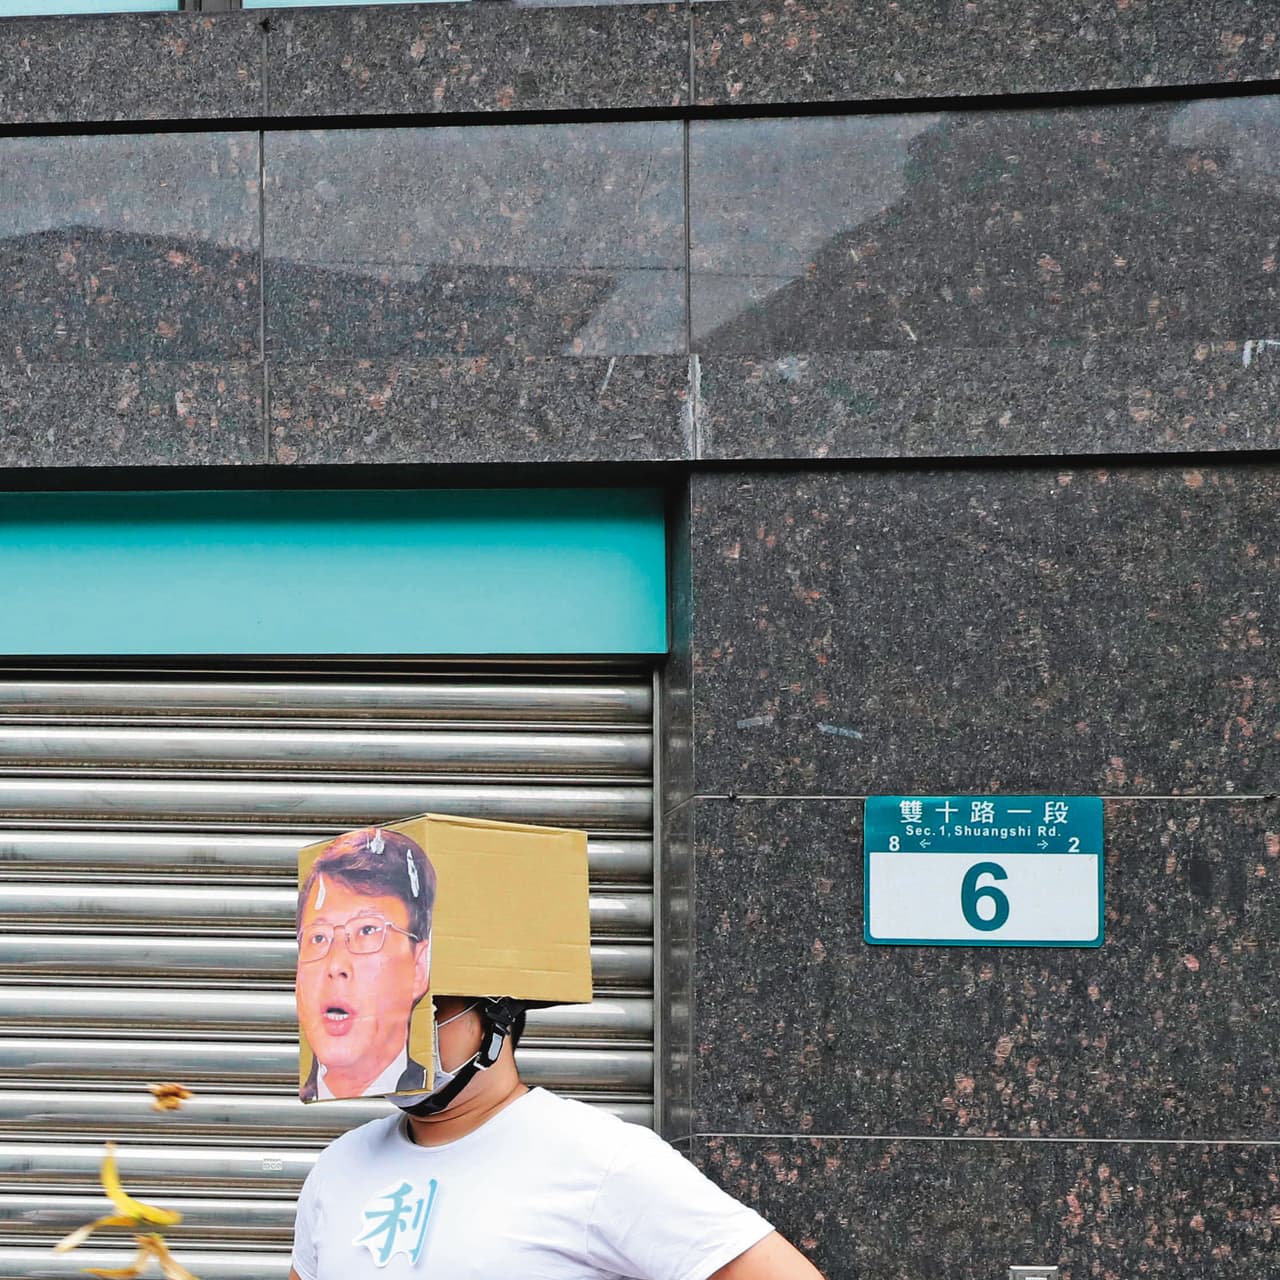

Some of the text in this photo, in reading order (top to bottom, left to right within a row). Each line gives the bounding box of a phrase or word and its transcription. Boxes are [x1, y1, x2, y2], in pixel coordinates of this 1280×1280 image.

[899, 800, 1069, 824] 雙十路一段
[1037, 825, 1062, 837] Rd.
[889, 835, 1081, 853] 8 2
[960, 861, 1011, 933] 6
